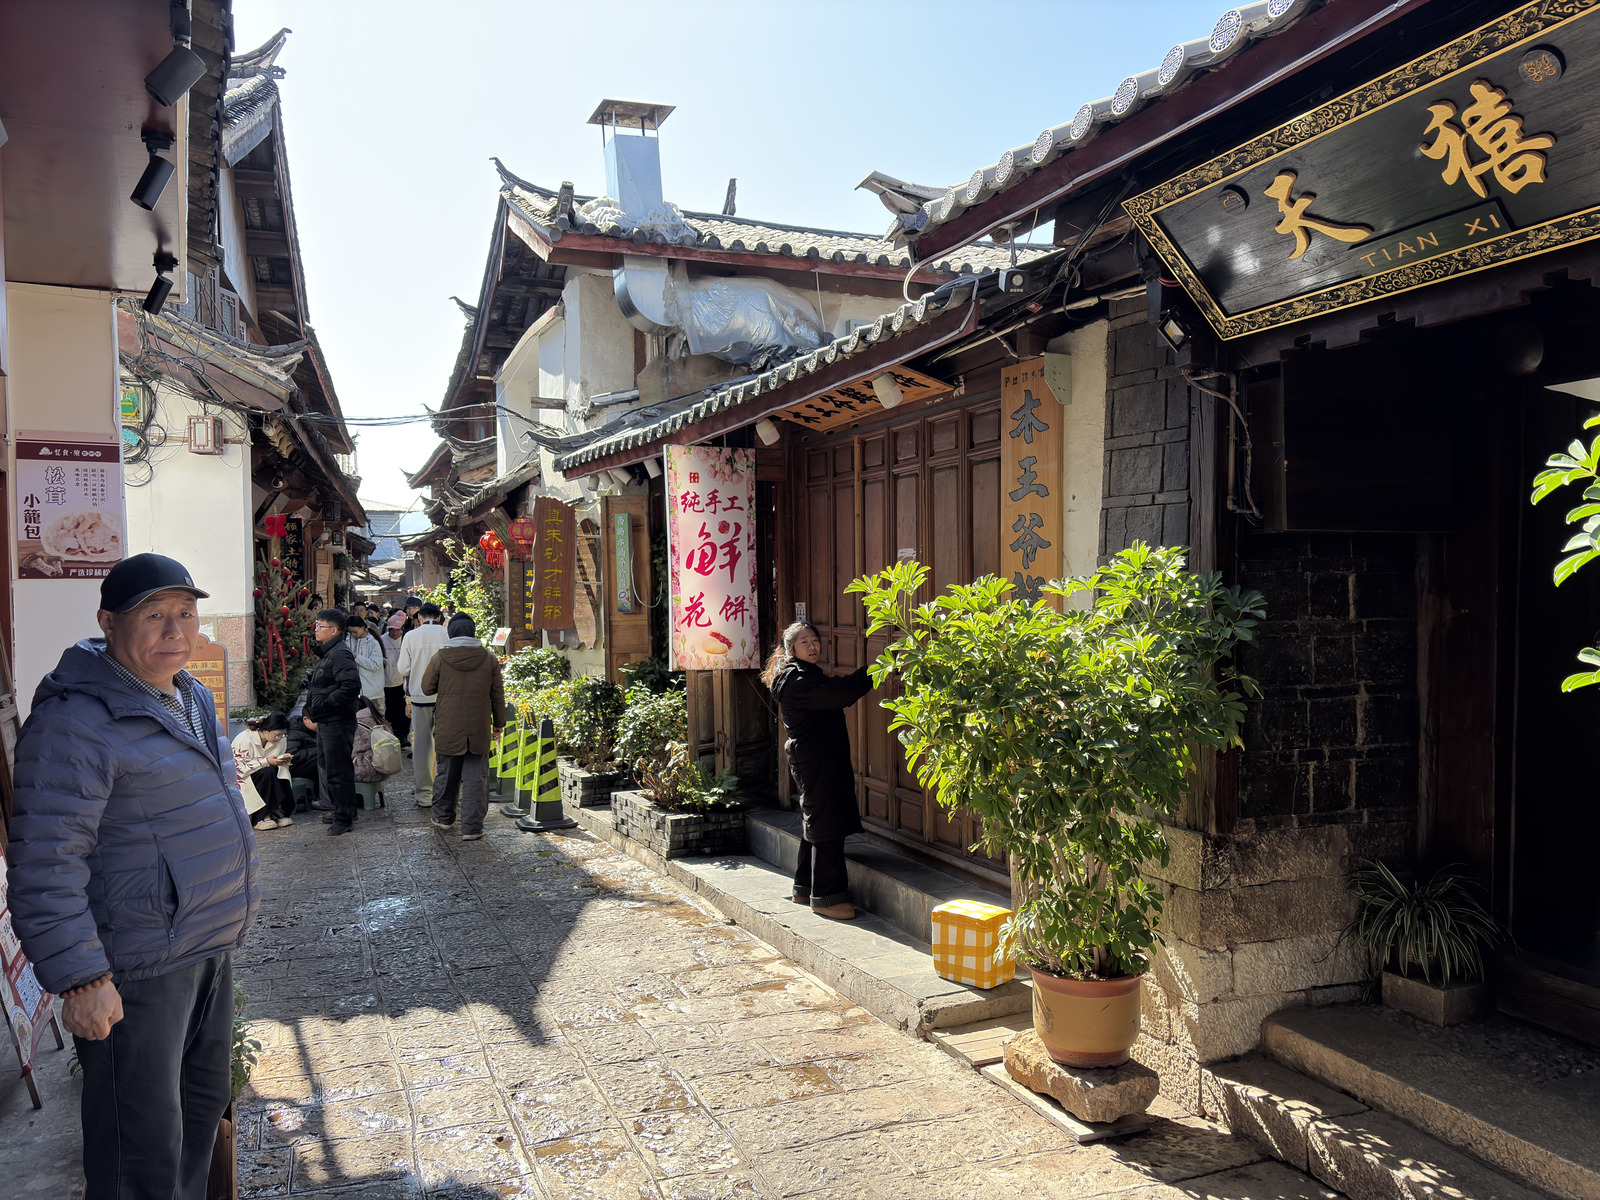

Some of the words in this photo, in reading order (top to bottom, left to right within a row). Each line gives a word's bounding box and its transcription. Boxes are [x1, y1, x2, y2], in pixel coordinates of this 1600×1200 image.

[1360, 231, 1439, 267] TIAN
[1464, 214, 1500, 236] XI
[45, 466, 66, 506] 松茸
[680, 488, 745, 515] 纯手工
[686, 522, 742, 584] 鲜
[681, 591, 751, 629] 花饼
